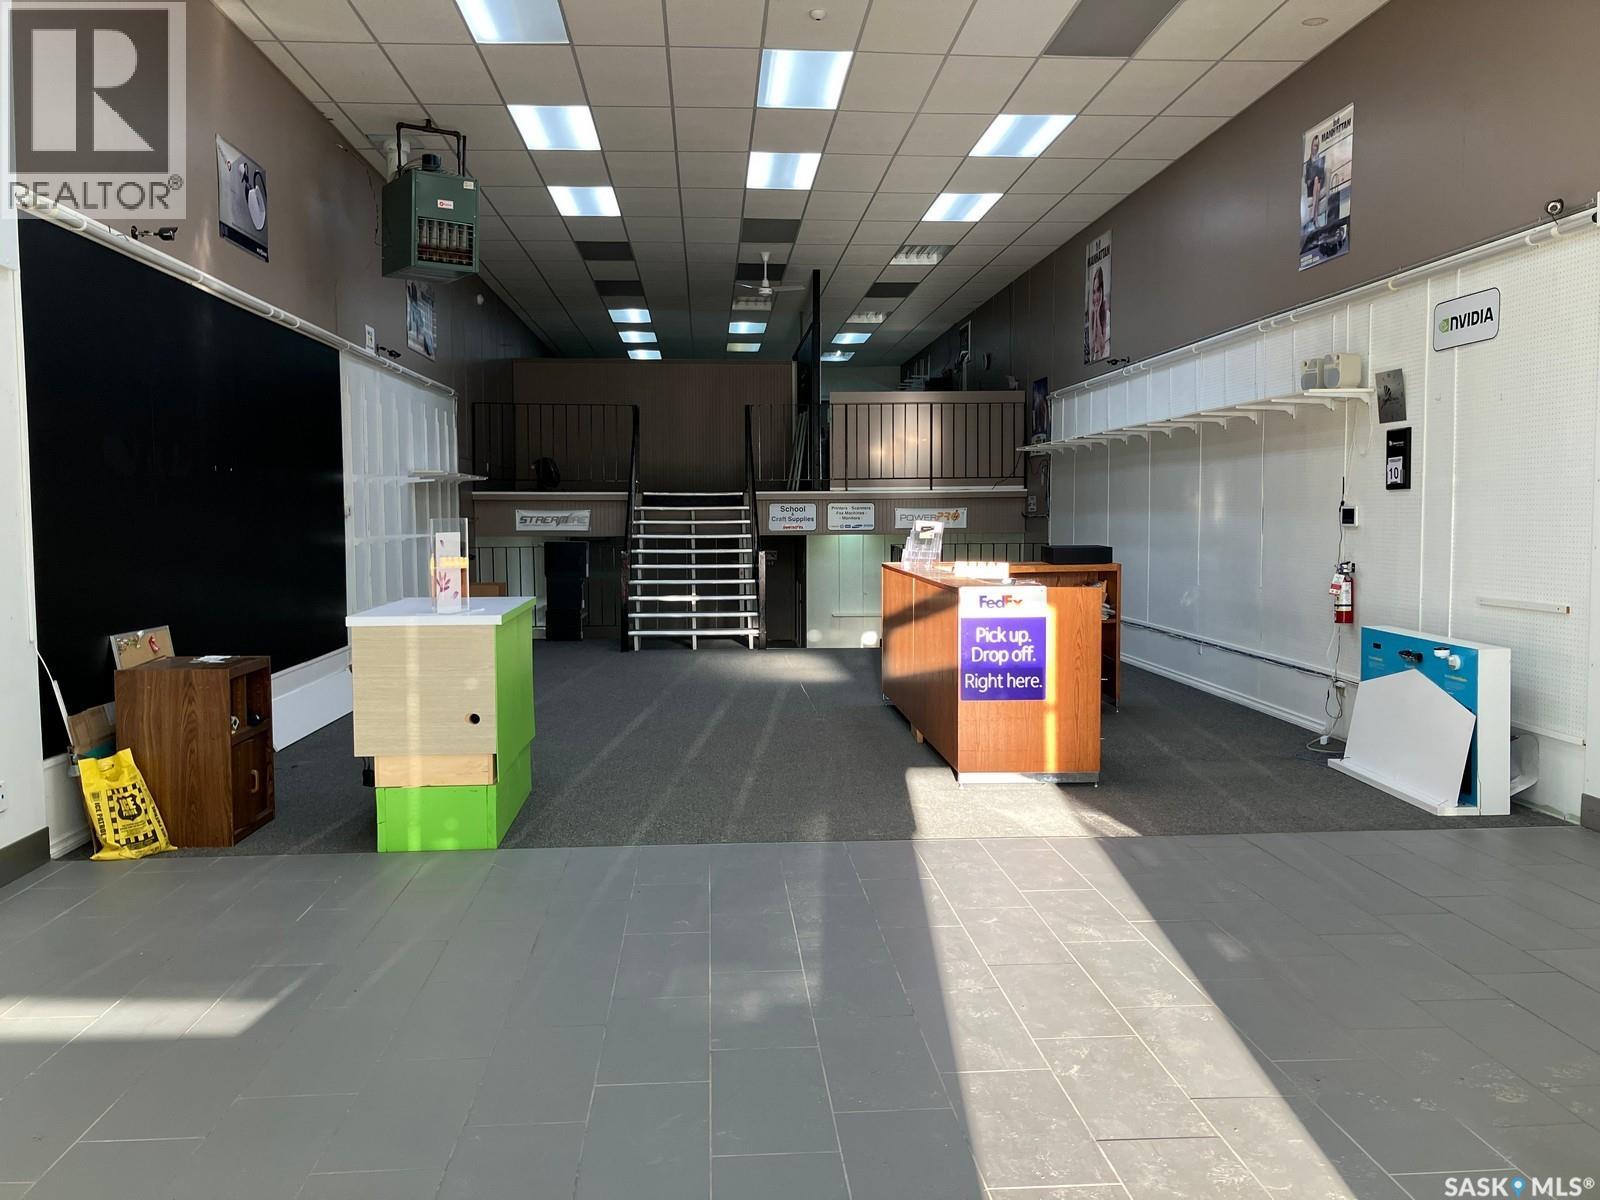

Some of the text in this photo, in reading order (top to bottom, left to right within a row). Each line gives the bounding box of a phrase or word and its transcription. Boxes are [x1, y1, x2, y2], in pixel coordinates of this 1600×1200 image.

[1389, 467, 1399, 480] 10
[780, 505, 806, 513] School
[787, 516, 814, 524] Supplies
[975, 626, 1032, 646] Pick up.
[971, 645, 1037, 666] Drop off.
[965, 672, 1043, 692] Right here.
